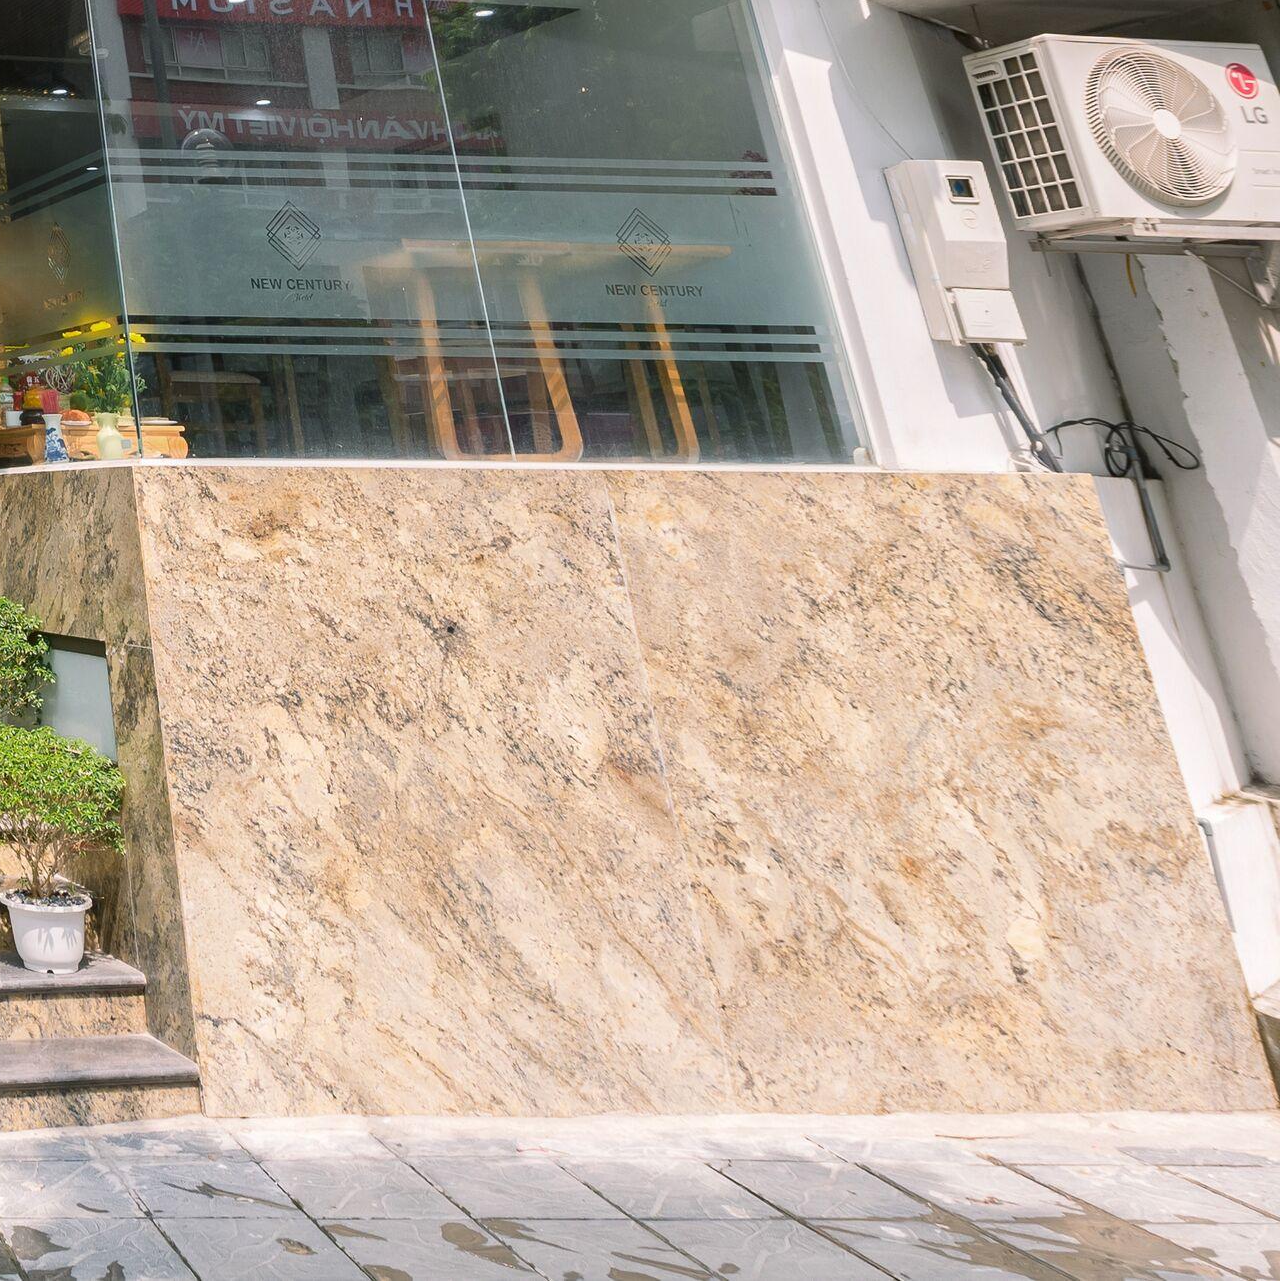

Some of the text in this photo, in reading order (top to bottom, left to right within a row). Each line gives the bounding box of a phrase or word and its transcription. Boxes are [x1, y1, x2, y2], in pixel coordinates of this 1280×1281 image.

[1240, 106, 1269, 124] LG
[251, 278, 351, 291] NEW CENTURY
[605, 284, 703, 297] NEW CENTURY
